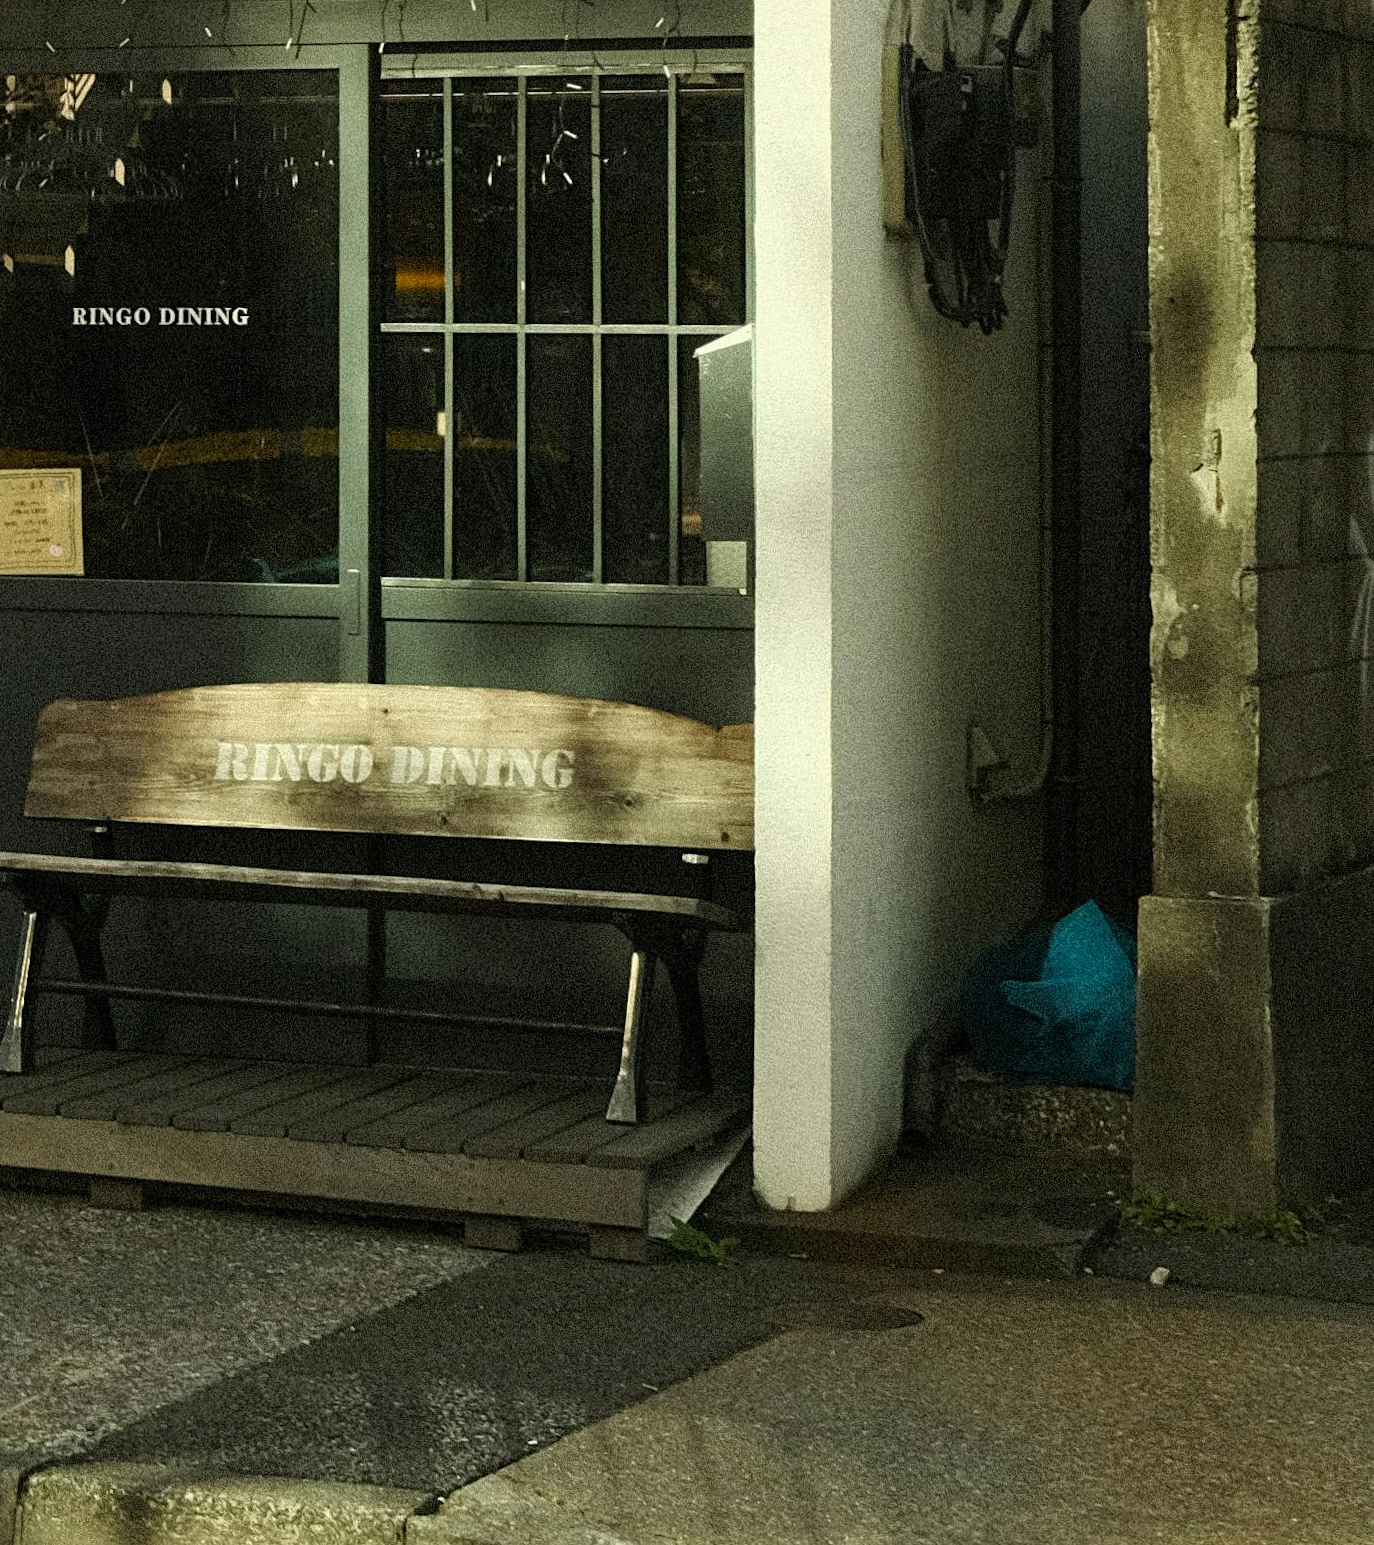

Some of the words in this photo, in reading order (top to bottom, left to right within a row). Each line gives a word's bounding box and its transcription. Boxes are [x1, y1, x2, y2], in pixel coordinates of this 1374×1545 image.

[72, 306, 151, 326] RINGO
[158, 306, 251, 326] DINING
[213, 741, 374, 784] RINGO
[389, 745, 576, 789] DINING
